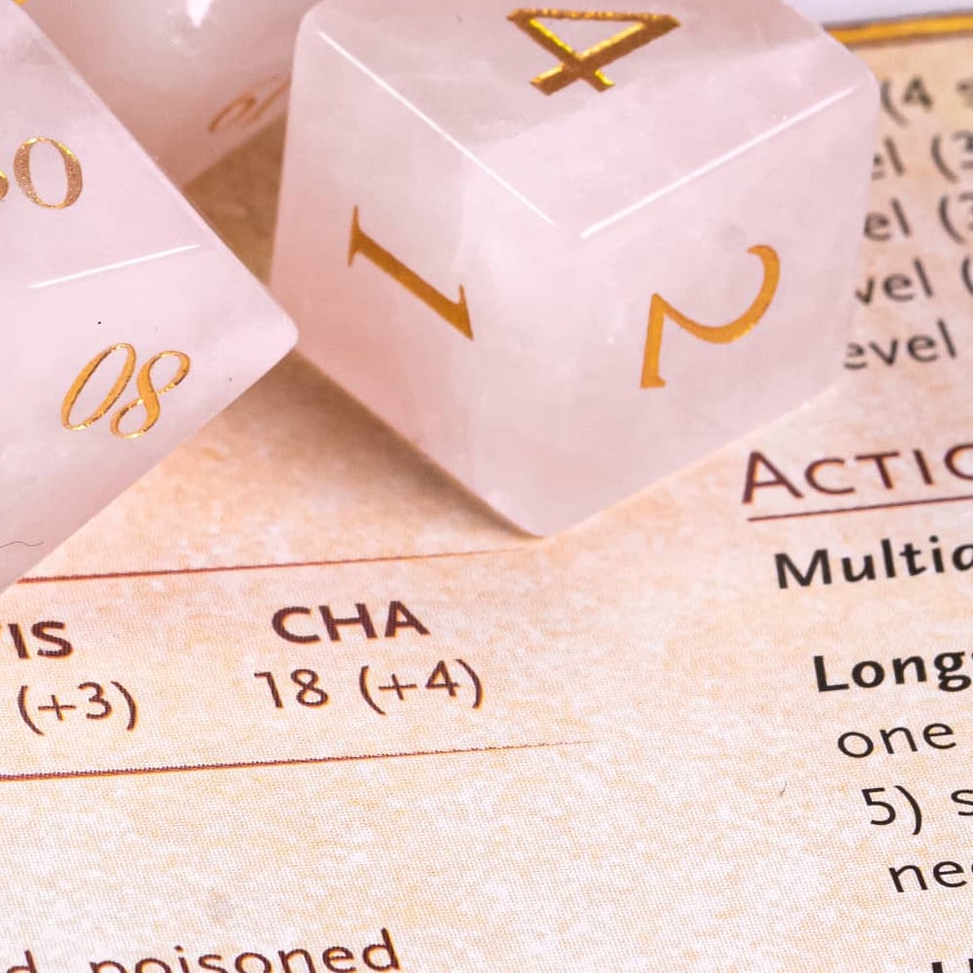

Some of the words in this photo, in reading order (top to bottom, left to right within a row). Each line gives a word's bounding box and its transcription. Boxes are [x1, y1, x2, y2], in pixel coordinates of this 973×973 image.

[507, 8, 682, 96] 4
[347, 205, 474, 341] 1
[855, 257, 933, 306] vel
[639, 244, 781, 388] 2
[844, 318, 956, 370] evel
[272, 600, 431, 643] CHA
[17, 681, 139, 735] (+3)
[254, 668, 330, 710] 18
[359, 658, 484, 715] (+4)
[813, 650, 973, 693] Long
[837, 721, 957, 759] one
[861, 785, 922, 836] 5)
[889, 861, 973, 894] ne
